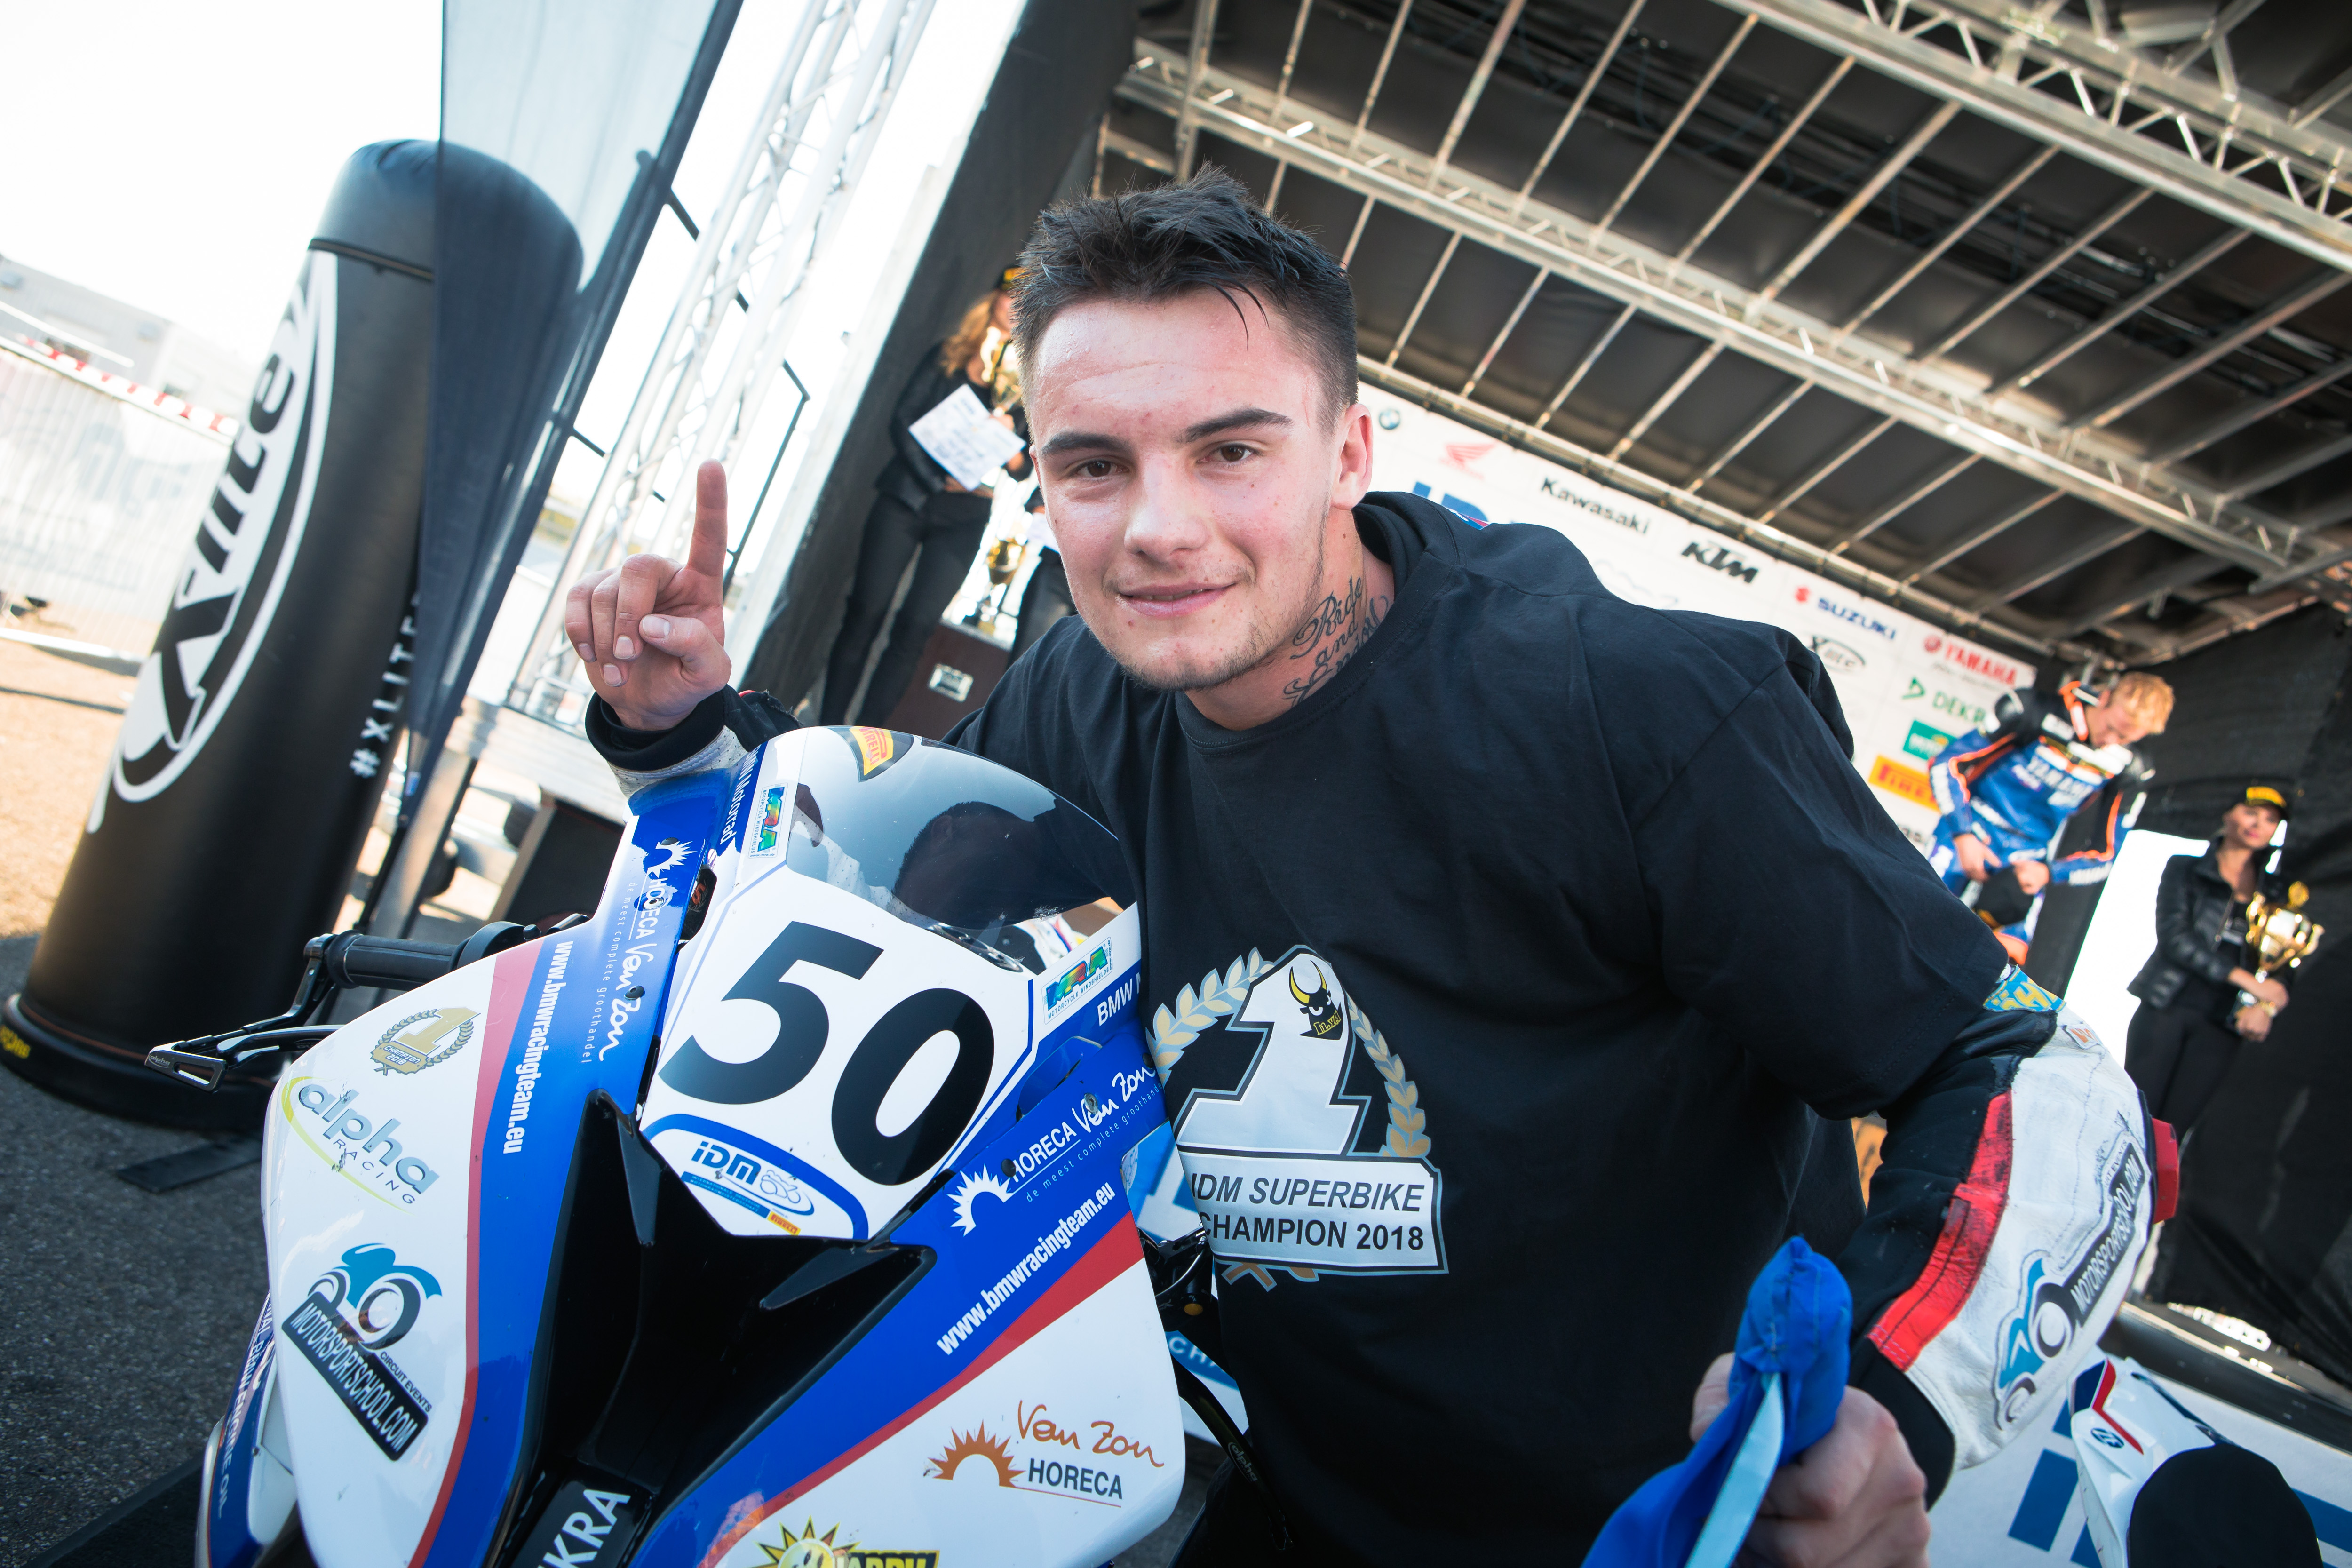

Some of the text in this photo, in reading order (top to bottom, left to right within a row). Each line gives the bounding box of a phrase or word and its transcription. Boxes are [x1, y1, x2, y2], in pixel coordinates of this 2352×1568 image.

[1541, 477, 1650, 535] Kawasaki
[1682, 542, 1758, 584] KTM
[1290, 575, 1361, 659] Ride
[1818, 597, 1896, 640] SUZUKI
[1945, 644, 2016, 687] YAMAHA
[1932, 691, 1986, 722] DEKR
[720, 774, 752, 845] Motorrad
[751, 789, 767, 853] MOTORCYCLE WINDSHIELDS
[635, 878, 668, 939] HOECA
[581, 882, 636, 1063] de meest complete groothandel
[1046, 946, 1108, 1011] MRA
[1048, 992, 1079, 1019] MOTORCYCLE
[1080, 967, 1109, 994] WINDSHIELDS
[1097, 978, 1133, 1027] BMW
[383, 1045, 421, 1064] CHAMPION
[386, 1054, 407, 1065] 2018
[503, 940, 573, 1154] www.bmwracingteam.eu
[599, 997, 641, 1061] Zon
[658, 921, 994, 1186] 50
[151, 1055, 170, 1065] alpha
[1112, 1067, 1156, 1102] Zon
[298, 1084, 440, 1194] alpha
[1026, 1083, 1162, 1202] de meest complete groothande
[333, 1139, 415, 1204] RACING
[1191, 1173, 1425, 1212] IDM SUPERBIKE
[1200, 1211, 1424, 1250] CHAMPION 2018
[936, 1182, 1115, 1355] www.bmwracingteam.eu
[290, 1302, 418, 1452] MOTORSPORTSCHOOL.COM
[380, 1352, 432, 1413] CIRCUIT EVENTS
[222, 1390, 247, 1475] ENGINE
[1091, 1421, 1164, 1467] Zon
[217, 1473, 229, 1519] OIL
[1028, 1458, 1122, 1500] HORECA
[537, 1489, 631, 1568] KRA
